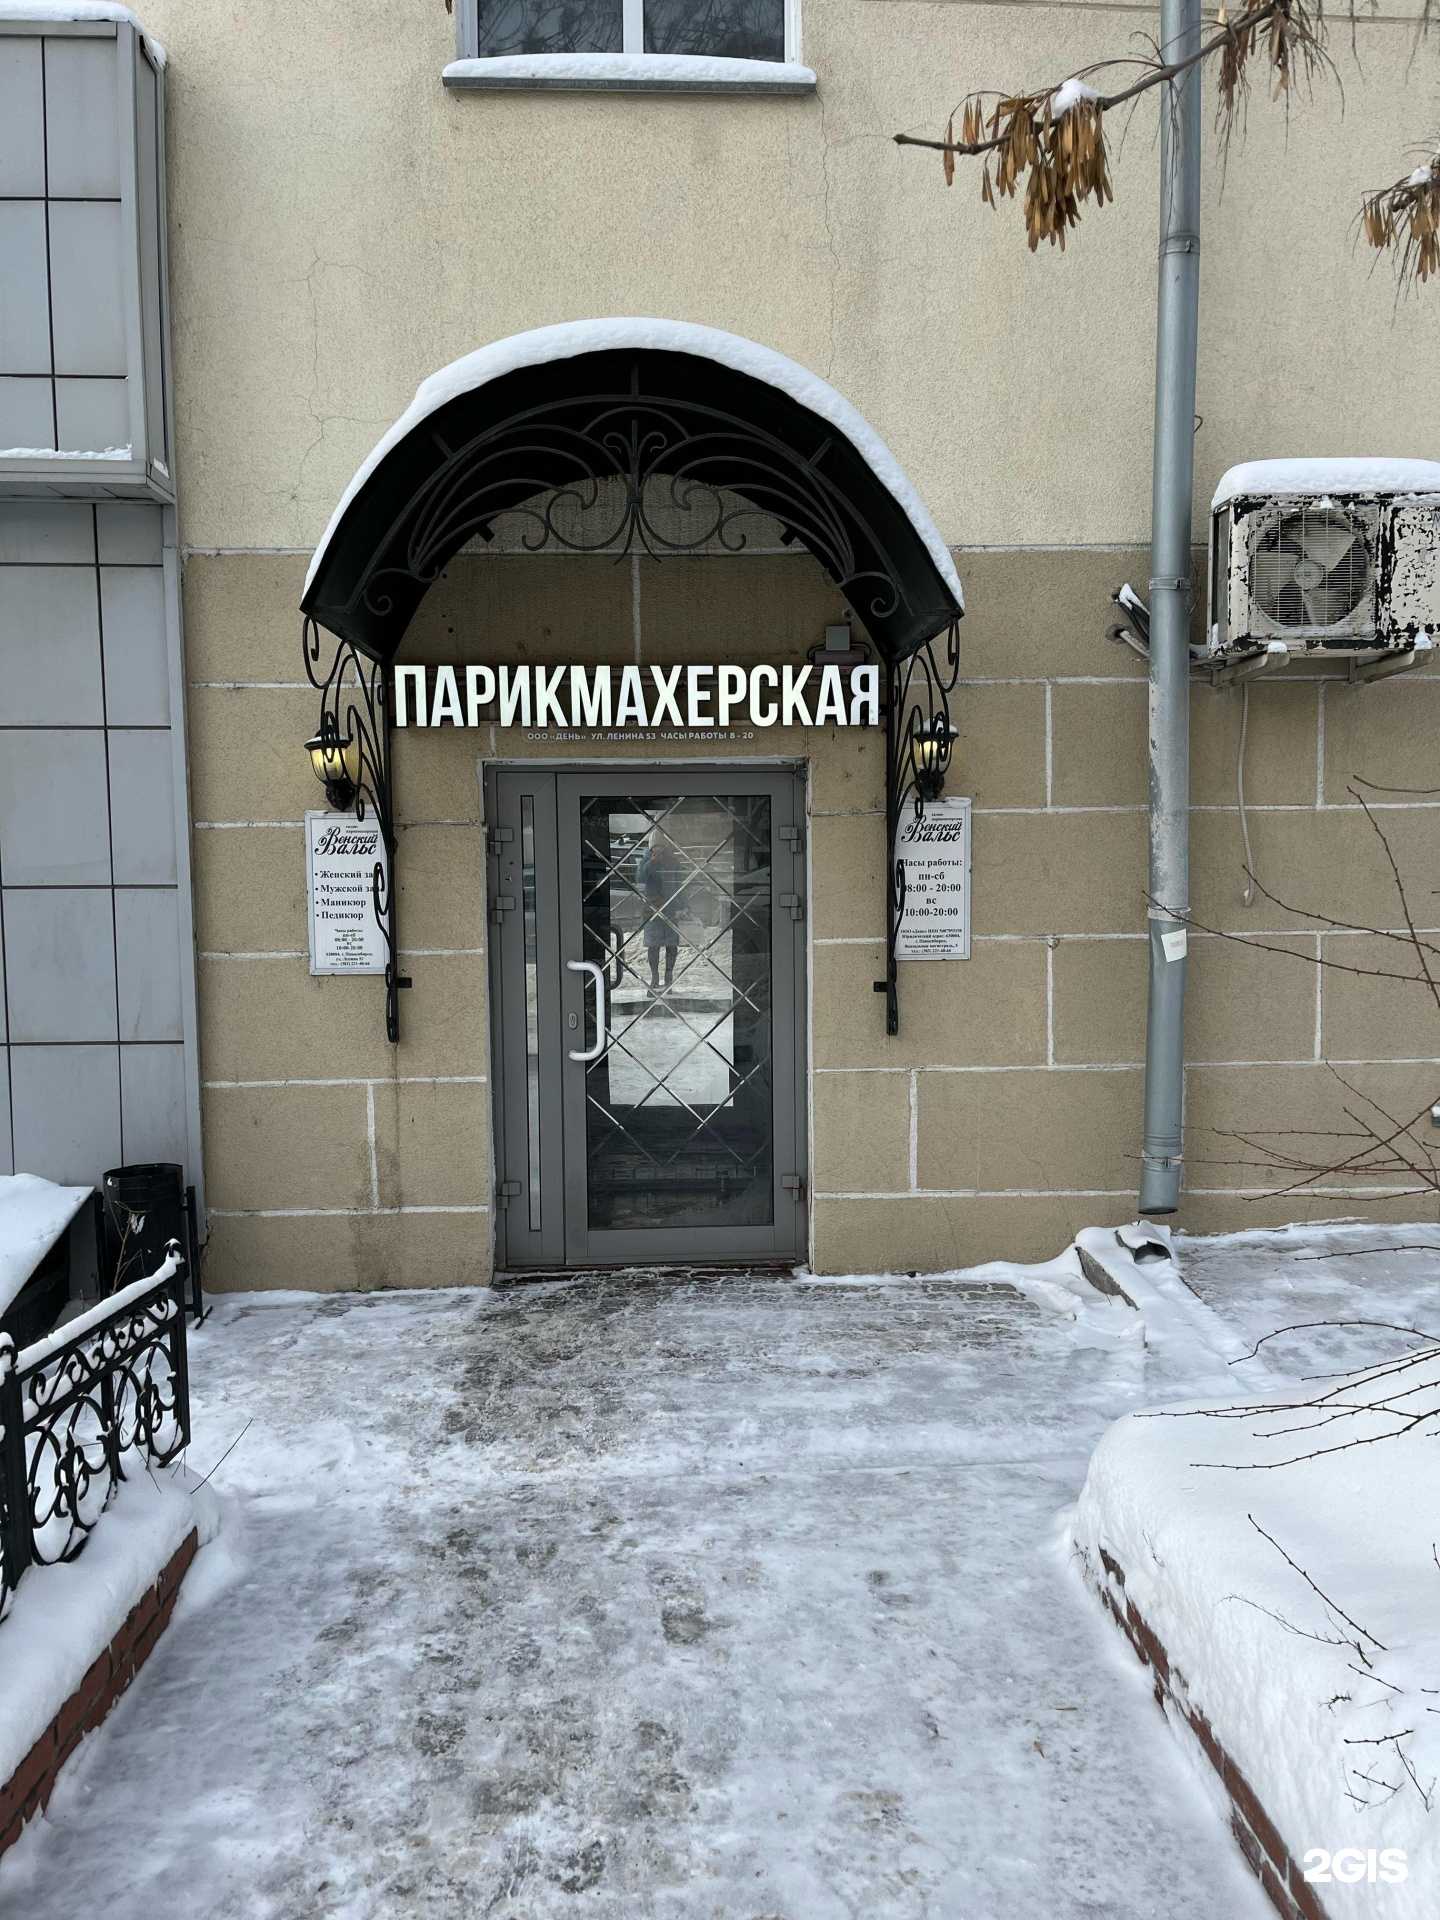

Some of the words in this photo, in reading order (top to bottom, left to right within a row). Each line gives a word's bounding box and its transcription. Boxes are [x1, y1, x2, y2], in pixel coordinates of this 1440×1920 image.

[394, 664, 880, 728] ПАРИКМАХЕРСКАЯ
[527, 732, 548, 740] ООО
[591, 732, 605, 741] УЛ.
[606, 732, 645, 740] ЛЕНИНА
[660, 731, 687, 740] ЧАСЫ
[688, 731, 727, 740] РАБОТЫ
[742, 731, 754, 739] 20
[927, 858, 963, 868] работы:
[319, 870, 362, 879] Женский
[918, 871, 945, 881] пн-сб
[320, 884, 363, 894] Мужской
[935, 883, 961, 893] 20:00
[321, 898, 367, 908] Маникюр
[321, 911, 364, 921] Педикюр
[905, 907, 959, 917] 10:00-20:00
